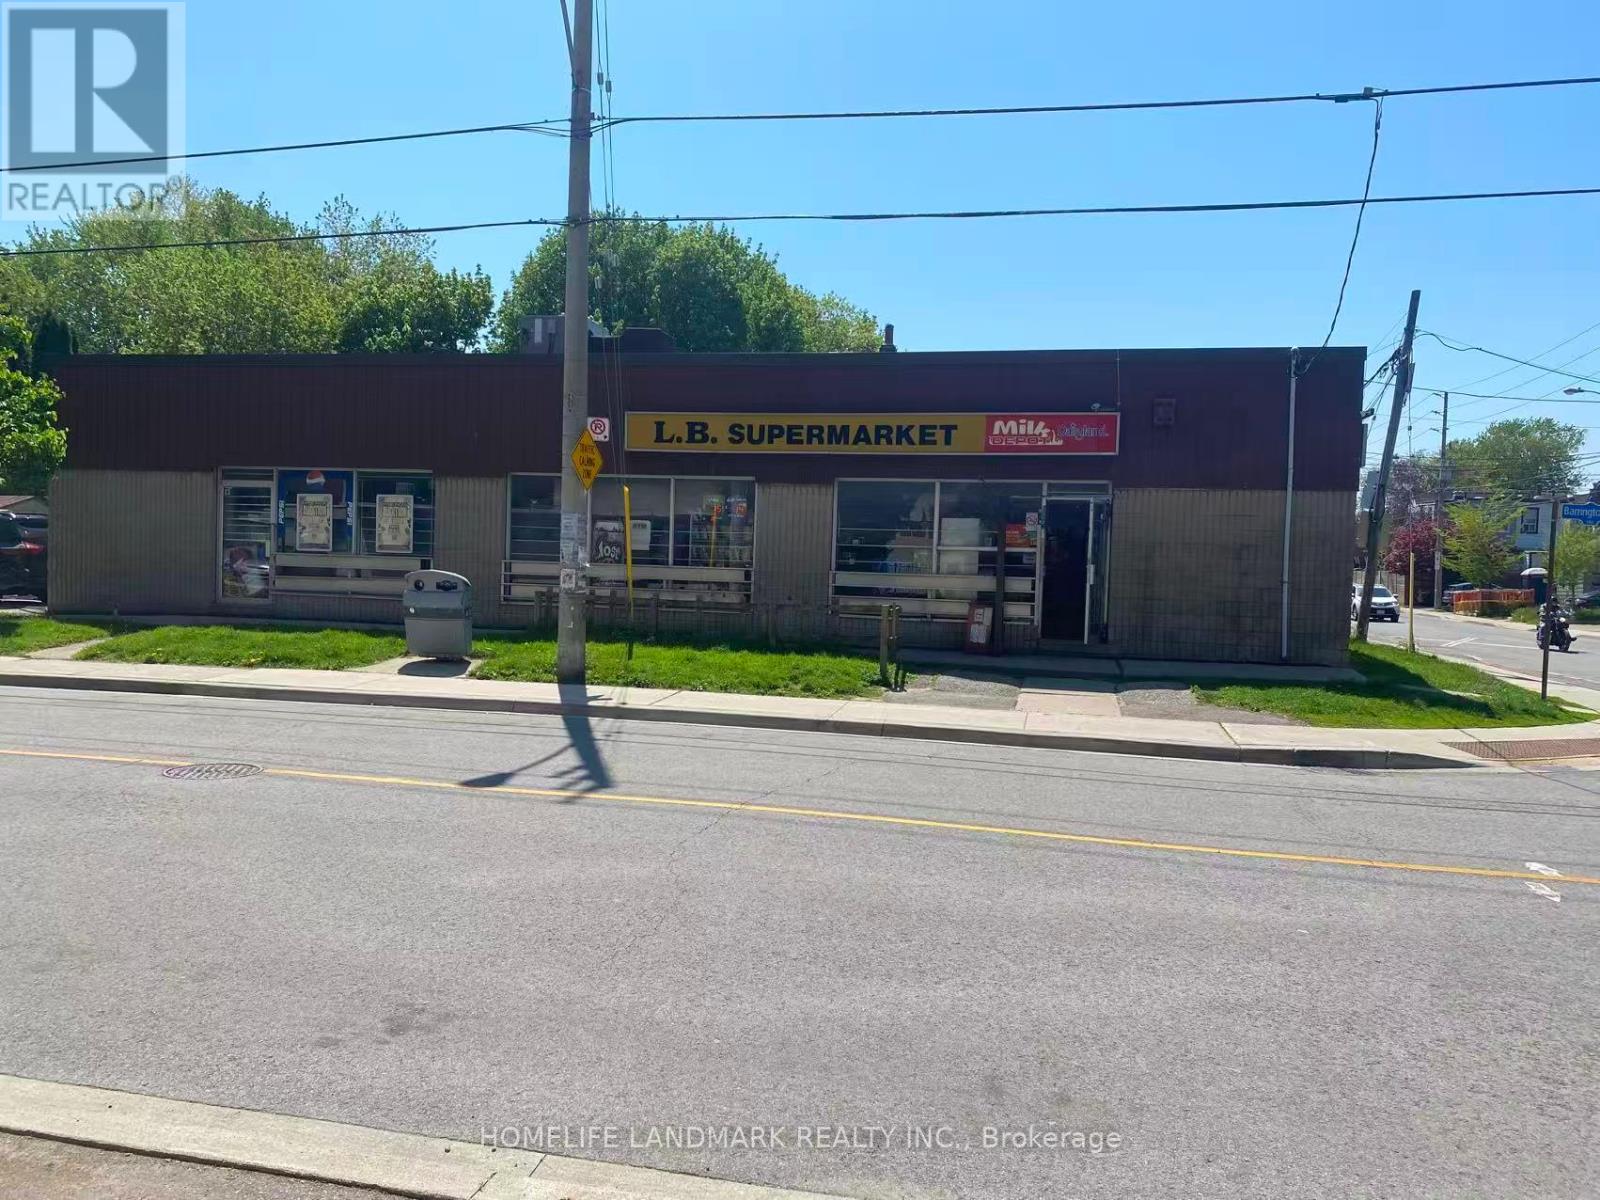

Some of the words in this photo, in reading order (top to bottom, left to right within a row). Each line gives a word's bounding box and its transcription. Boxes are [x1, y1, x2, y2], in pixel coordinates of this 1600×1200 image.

[654, 420, 718, 443] L.B.
[728, 423, 958, 446] SUPERMARKET
[992, 418, 1048, 438] Milk
